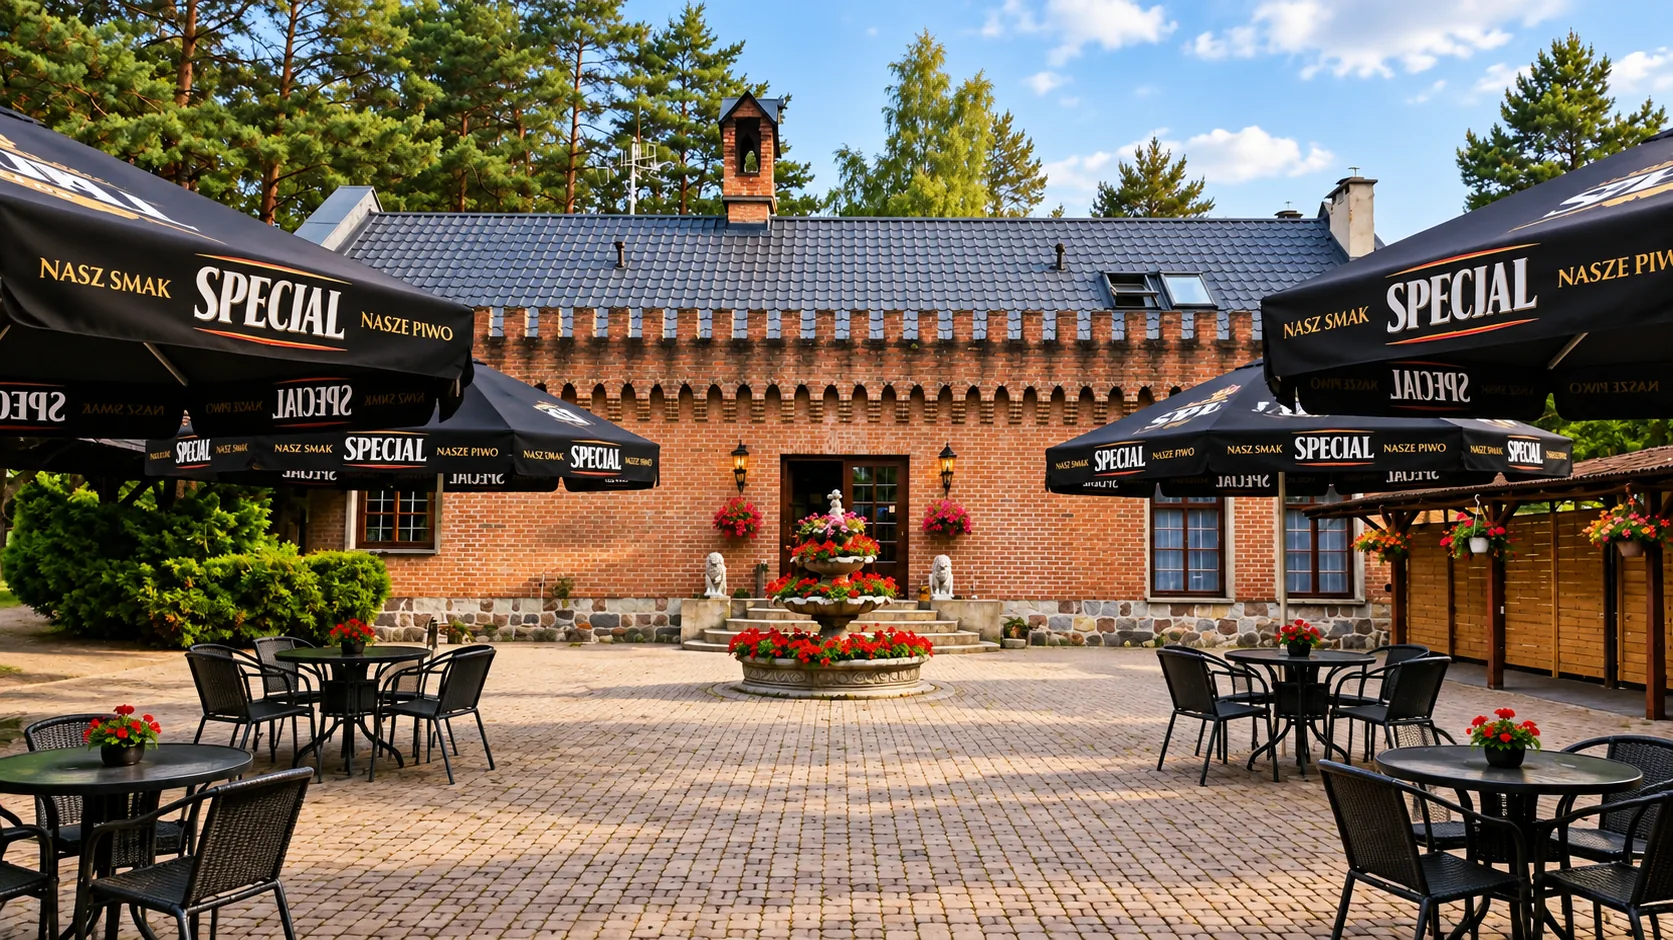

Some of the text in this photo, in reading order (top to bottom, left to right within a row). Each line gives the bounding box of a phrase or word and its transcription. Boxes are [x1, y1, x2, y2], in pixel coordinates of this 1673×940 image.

[39, 257, 454, 342] NASZ SMAK SPECIAL NASZE PIWO
[1283, 315, 1321, 339] NASZ
[1324, 305, 1370, 330] SMAK
[1386, 257, 1538, 334] SPECIAL
[1557, 256, 1630, 288] NASZE
[176, 439, 211, 464] SPECIAL
[274, 436, 499, 462] NASZ SMAK SPECIAL NASZE PIWO
[570, 445, 621, 470] SPECIAL
[1094, 445, 1146, 471] SPECIAL
[1227, 435, 1447, 460] NASZ SMAK SPECIAL NASZE PIWO
[1507, 440, 1543, 464] SPECIAL
